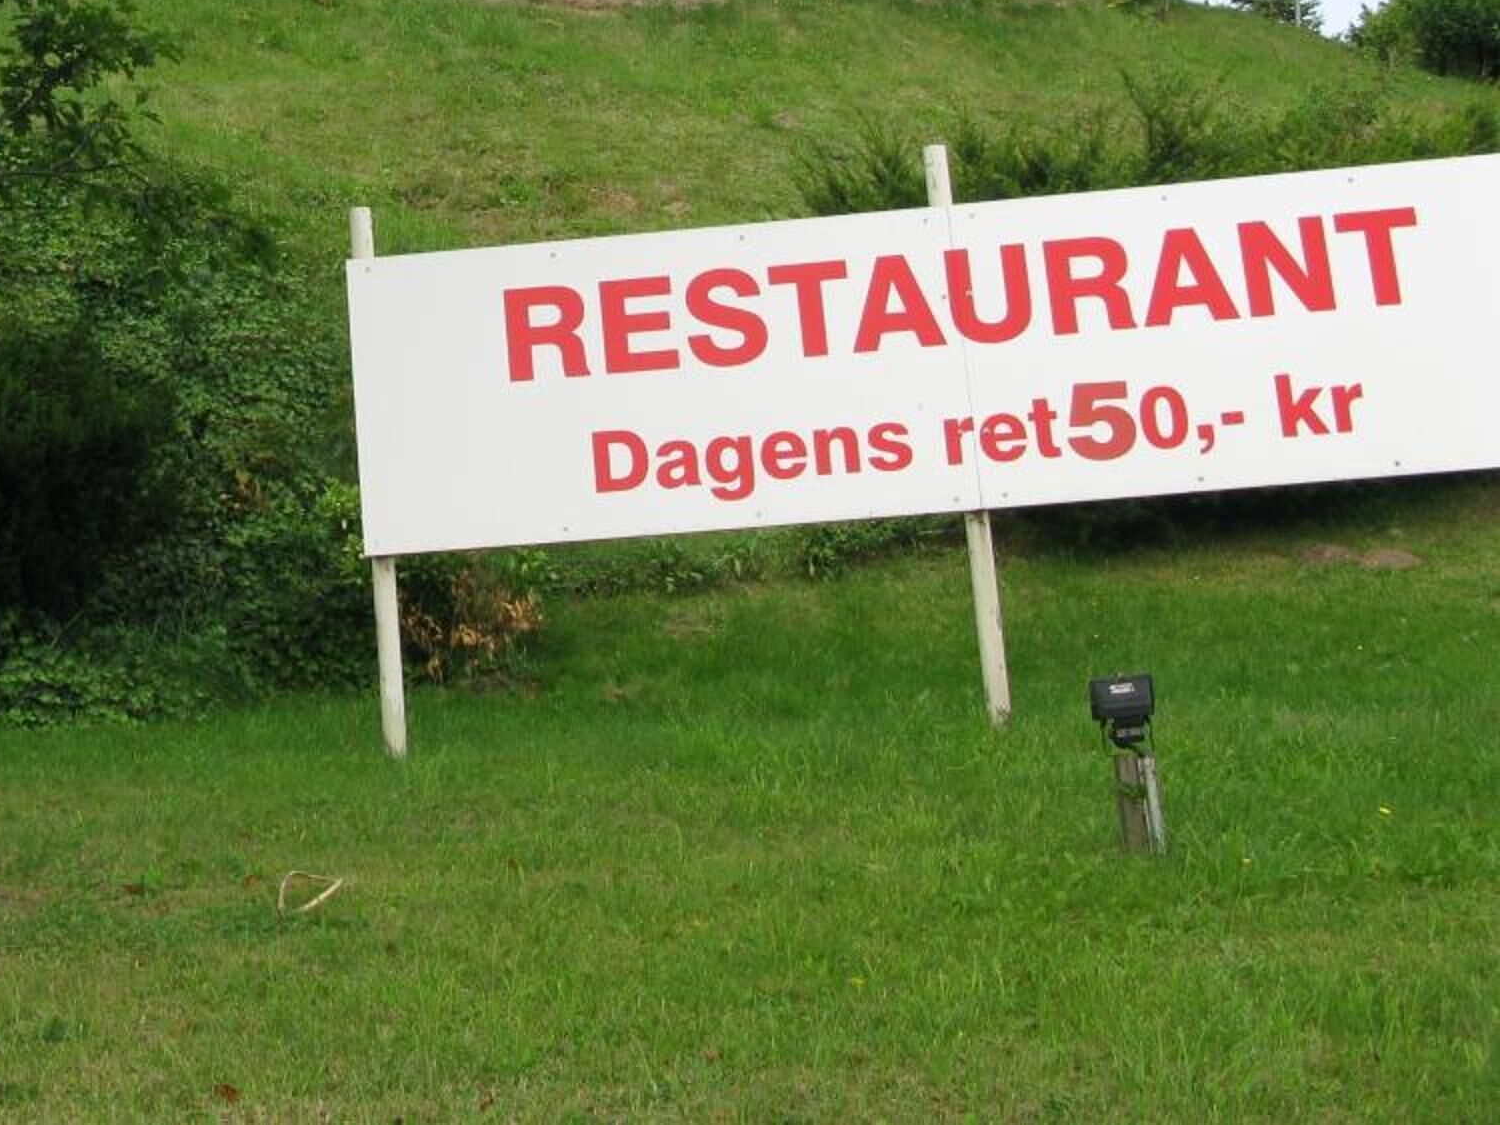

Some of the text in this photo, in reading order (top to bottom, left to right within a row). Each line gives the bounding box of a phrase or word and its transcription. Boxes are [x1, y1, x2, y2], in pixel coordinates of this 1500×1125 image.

[502, 205, 1419, 382] RESTAURANT
[591, 421, 914, 503] Dagens
[1274, 373, 1363, 439] kr
